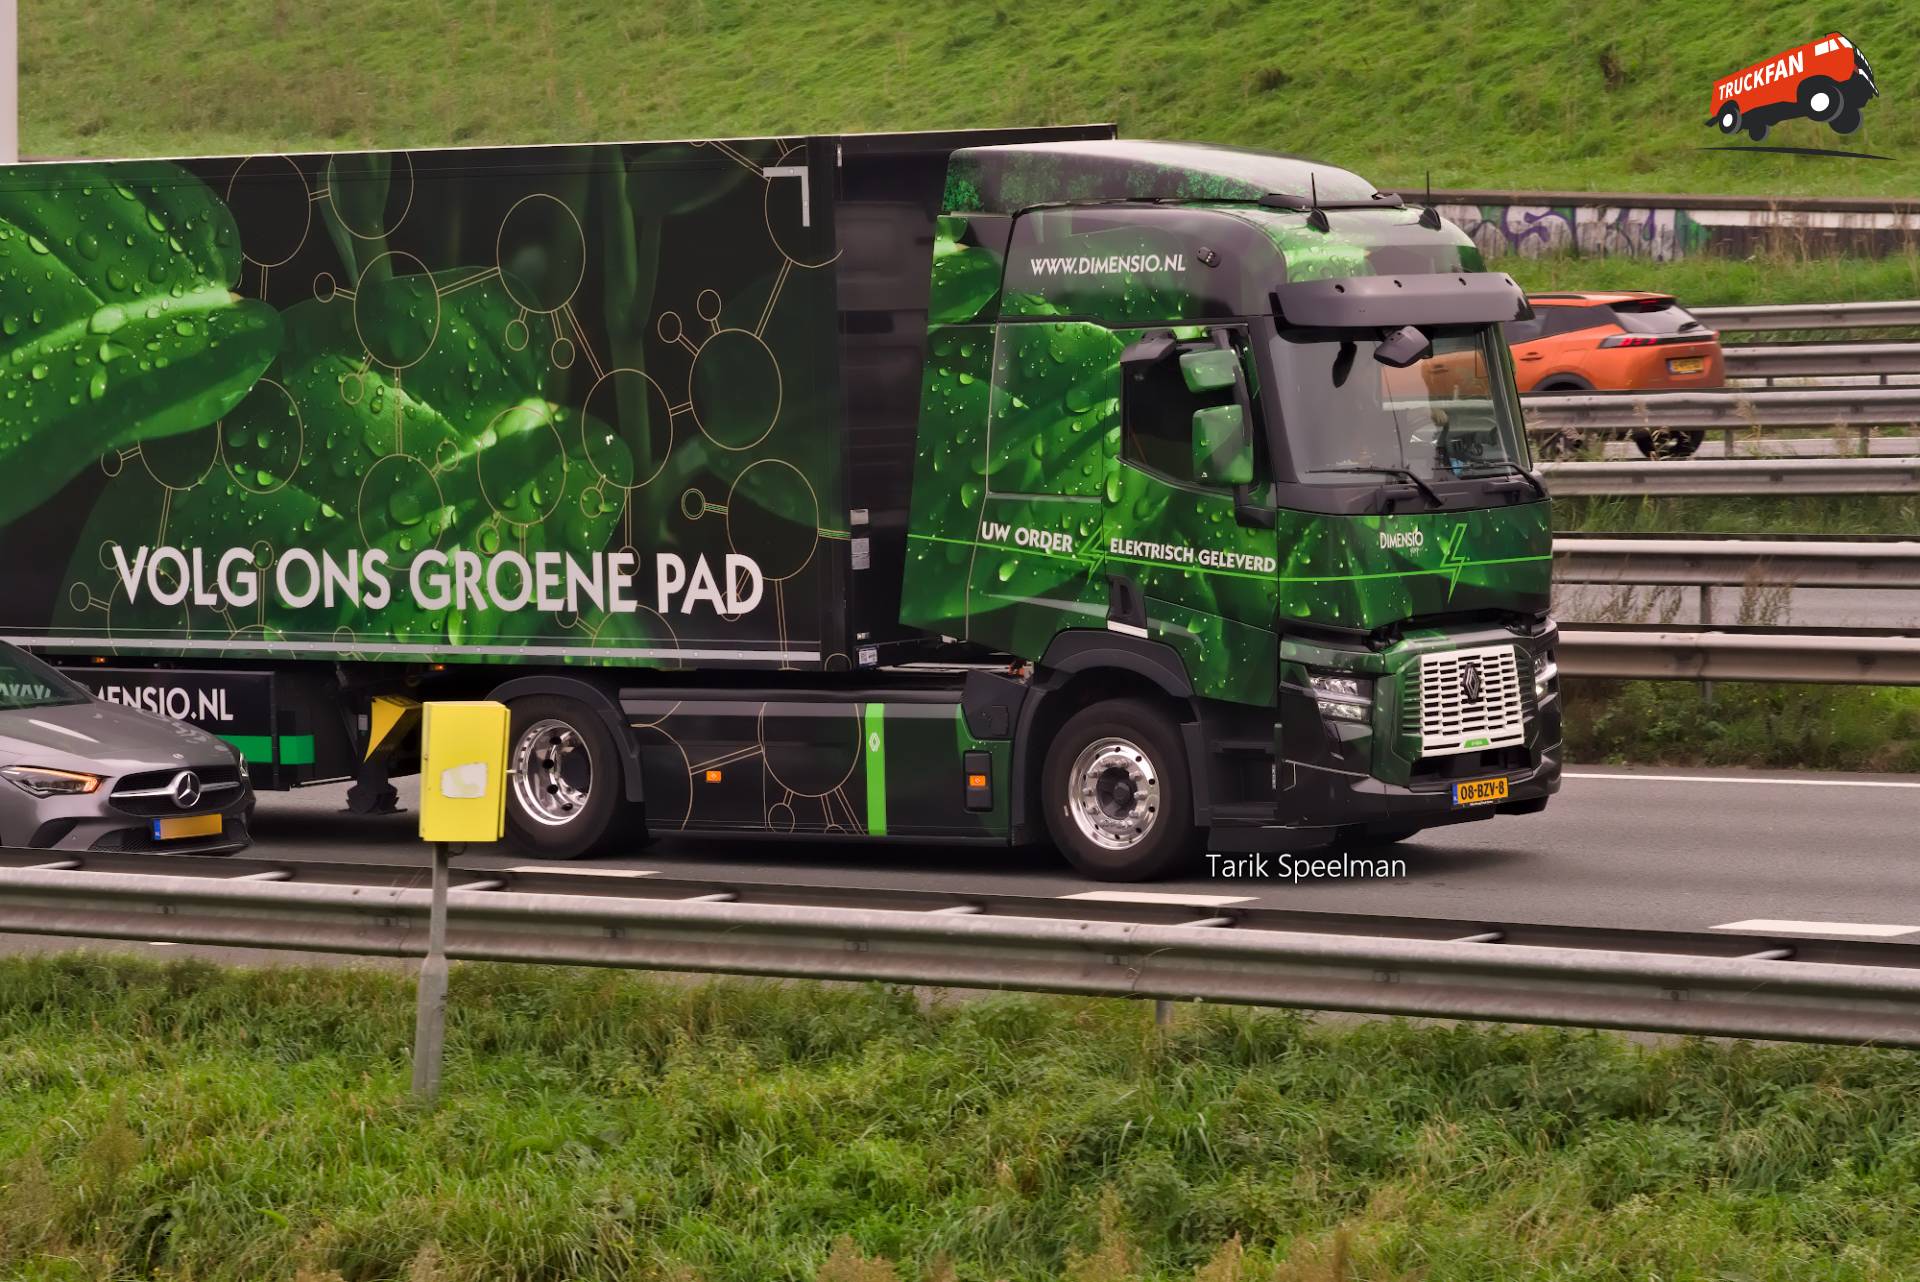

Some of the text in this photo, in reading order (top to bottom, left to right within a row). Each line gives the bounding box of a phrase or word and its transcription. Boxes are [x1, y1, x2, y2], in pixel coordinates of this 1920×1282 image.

[1030, 254, 1186, 276] WWW.DIMENSIO.NL
[981, 521, 1277, 573] UW ORDER ELEKTRISCH GELEVERD
[1379, 531, 1424, 549] DIMENSIO
[112, 545, 764, 615] VOLG ONS GROENE PAD
[1460, 780, 1504, 800] 08-BZV-8
